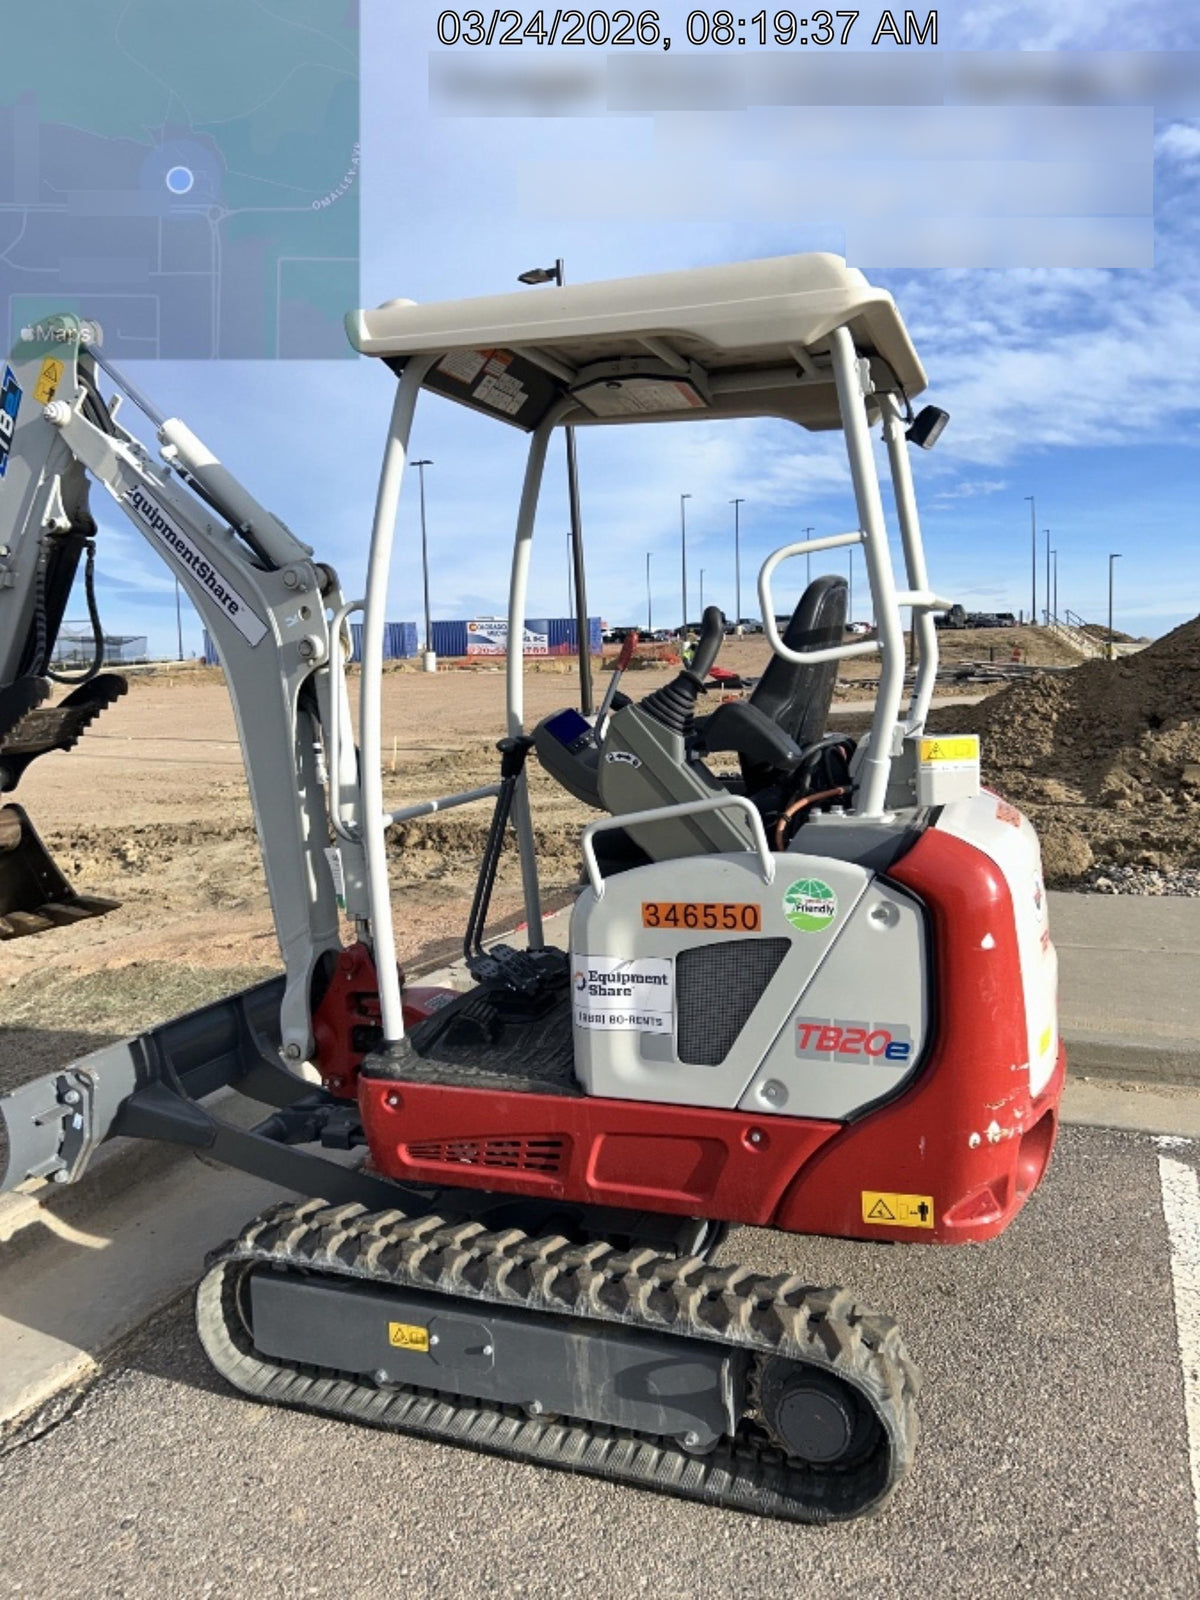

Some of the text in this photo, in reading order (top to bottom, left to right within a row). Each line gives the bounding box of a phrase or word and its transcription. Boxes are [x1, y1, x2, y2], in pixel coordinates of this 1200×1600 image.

[645, 902, 758, 930] 346550
[588, 970, 668, 986] Equipment
[588, 984, 632, 997] Share
[797, 1023, 911, 1061] TB20e
